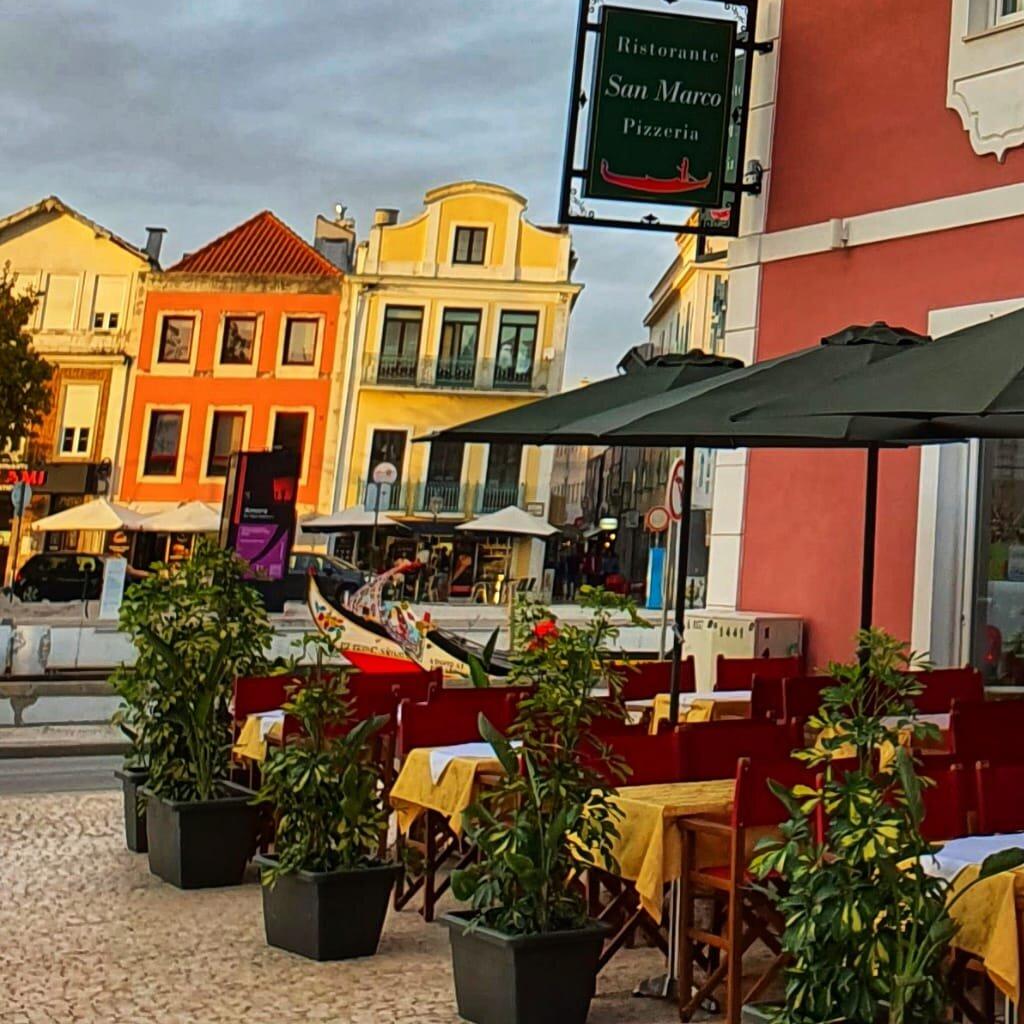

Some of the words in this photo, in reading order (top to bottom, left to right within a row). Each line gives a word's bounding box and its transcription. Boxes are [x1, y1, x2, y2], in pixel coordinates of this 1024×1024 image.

[617, 36, 719, 62] Ristorante
[605, 74, 648, 100] San
[654, 79, 722, 108] Marco
[623, 117, 699, 141] Pizzeria
